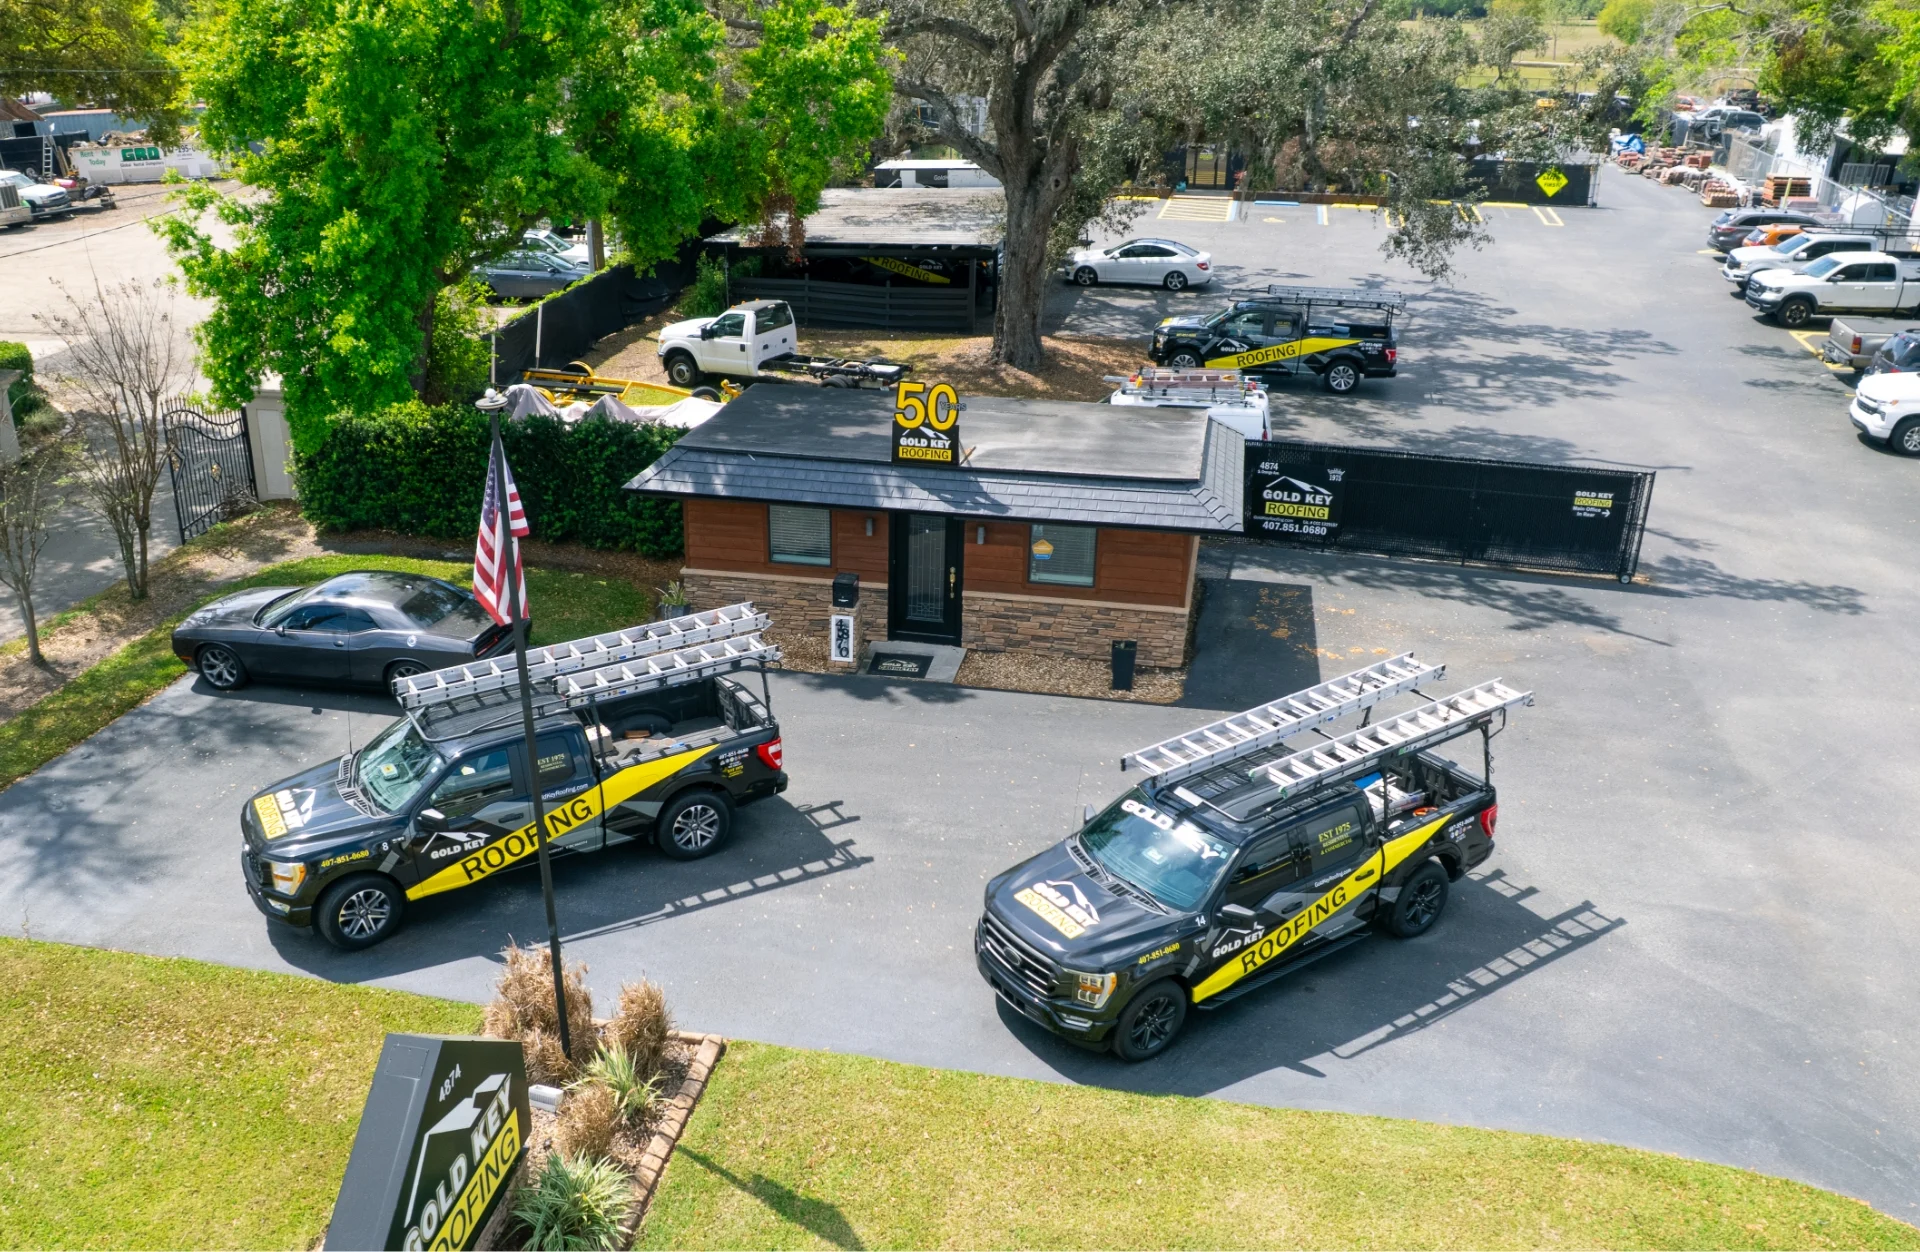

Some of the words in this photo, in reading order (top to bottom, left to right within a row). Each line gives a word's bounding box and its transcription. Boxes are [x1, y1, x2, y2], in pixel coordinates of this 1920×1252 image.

[88, 159, 106, 167] Today
[880, 257, 930, 281] ROOFING
[1236, 345, 1296, 367] ROOFING
[894, 381, 959, 430] 50
[939, 401, 967, 411] YEARS
[900, 437, 928, 447] GOLD
[930, 439, 951, 449] KEY
[901, 447, 949, 460] ROOFING
[1260, 461, 1279, 470] 4874
[1329, 474, 1342, 482] 1975
[1262, 489, 1301, 502] GOLD
[1305, 494, 1333, 505] KEY
[1575, 490, 1597, 498] GOLD
[1576, 498, 1611, 507] ROOFING
[1268, 503, 1326, 518] ROOFING
[1262, 521, 1327, 535] 407.851.0680
[537, 757, 549, 766] EST
[550, 753, 565, 761] 1975
[541, 783, 588, 800] ldKeyRoofing.com
[257, 795, 284, 836] ROOFING
[1121, 799, 1174, 831] GOLD
[461, 799, 593, 881] ROOFING
[1318, 828, 1333, 842] EST
[1335, 822, 1352, 836] 1975
[382, 842, 389, 851] 8
[430, 845, 462, 859] GOLD
[463, 838, 486, 851] KEY
[320, 849, 369, 868] 407-851-0680
[1022, 892, 1078, 934] ROOFING
[1195, 915, 1206, 927] 14
[1240, 886, 1347, 974] ROOFING
[1212, 939, 1242, 958] GOLD
[1243, 929, 1265, 946] KEY
[1138, 942, 1180, 965] 407-851-0680
[439, 1063, 462, 1103] 4874
[403, 1153, 468, 1252] GOLD
[470, 1072, 512, 1166] KEY
